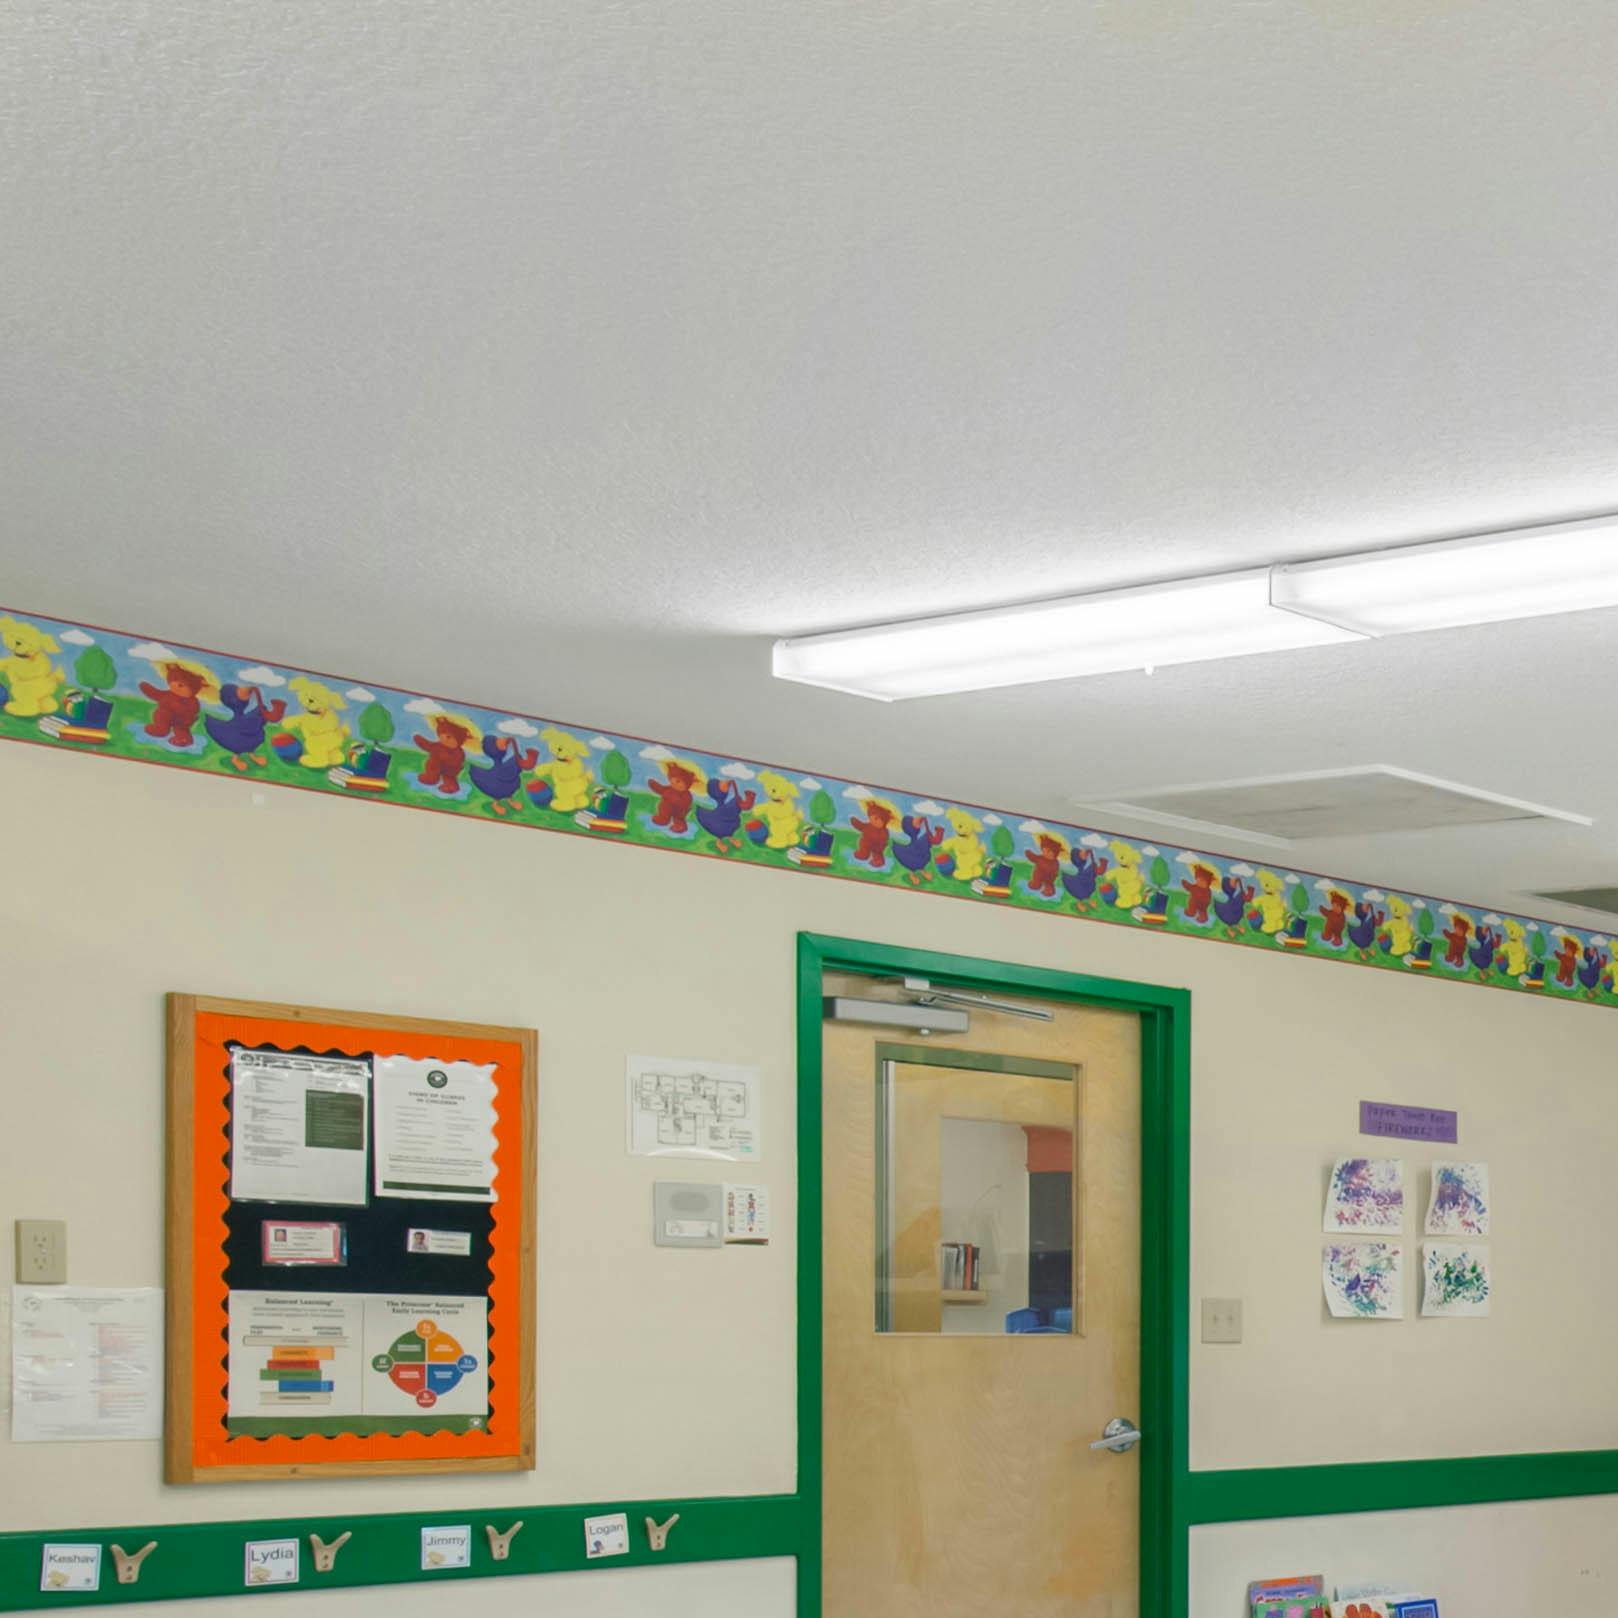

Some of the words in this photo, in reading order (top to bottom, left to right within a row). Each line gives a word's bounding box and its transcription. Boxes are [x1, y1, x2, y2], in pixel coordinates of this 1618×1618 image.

[589, 1523, 624, 1535] Logan
[427, 1536, 466, 1547] Jimmy
[48, 1553, 96, 1564] Keshav
[251, 1547, 294, 1564] Lydia
